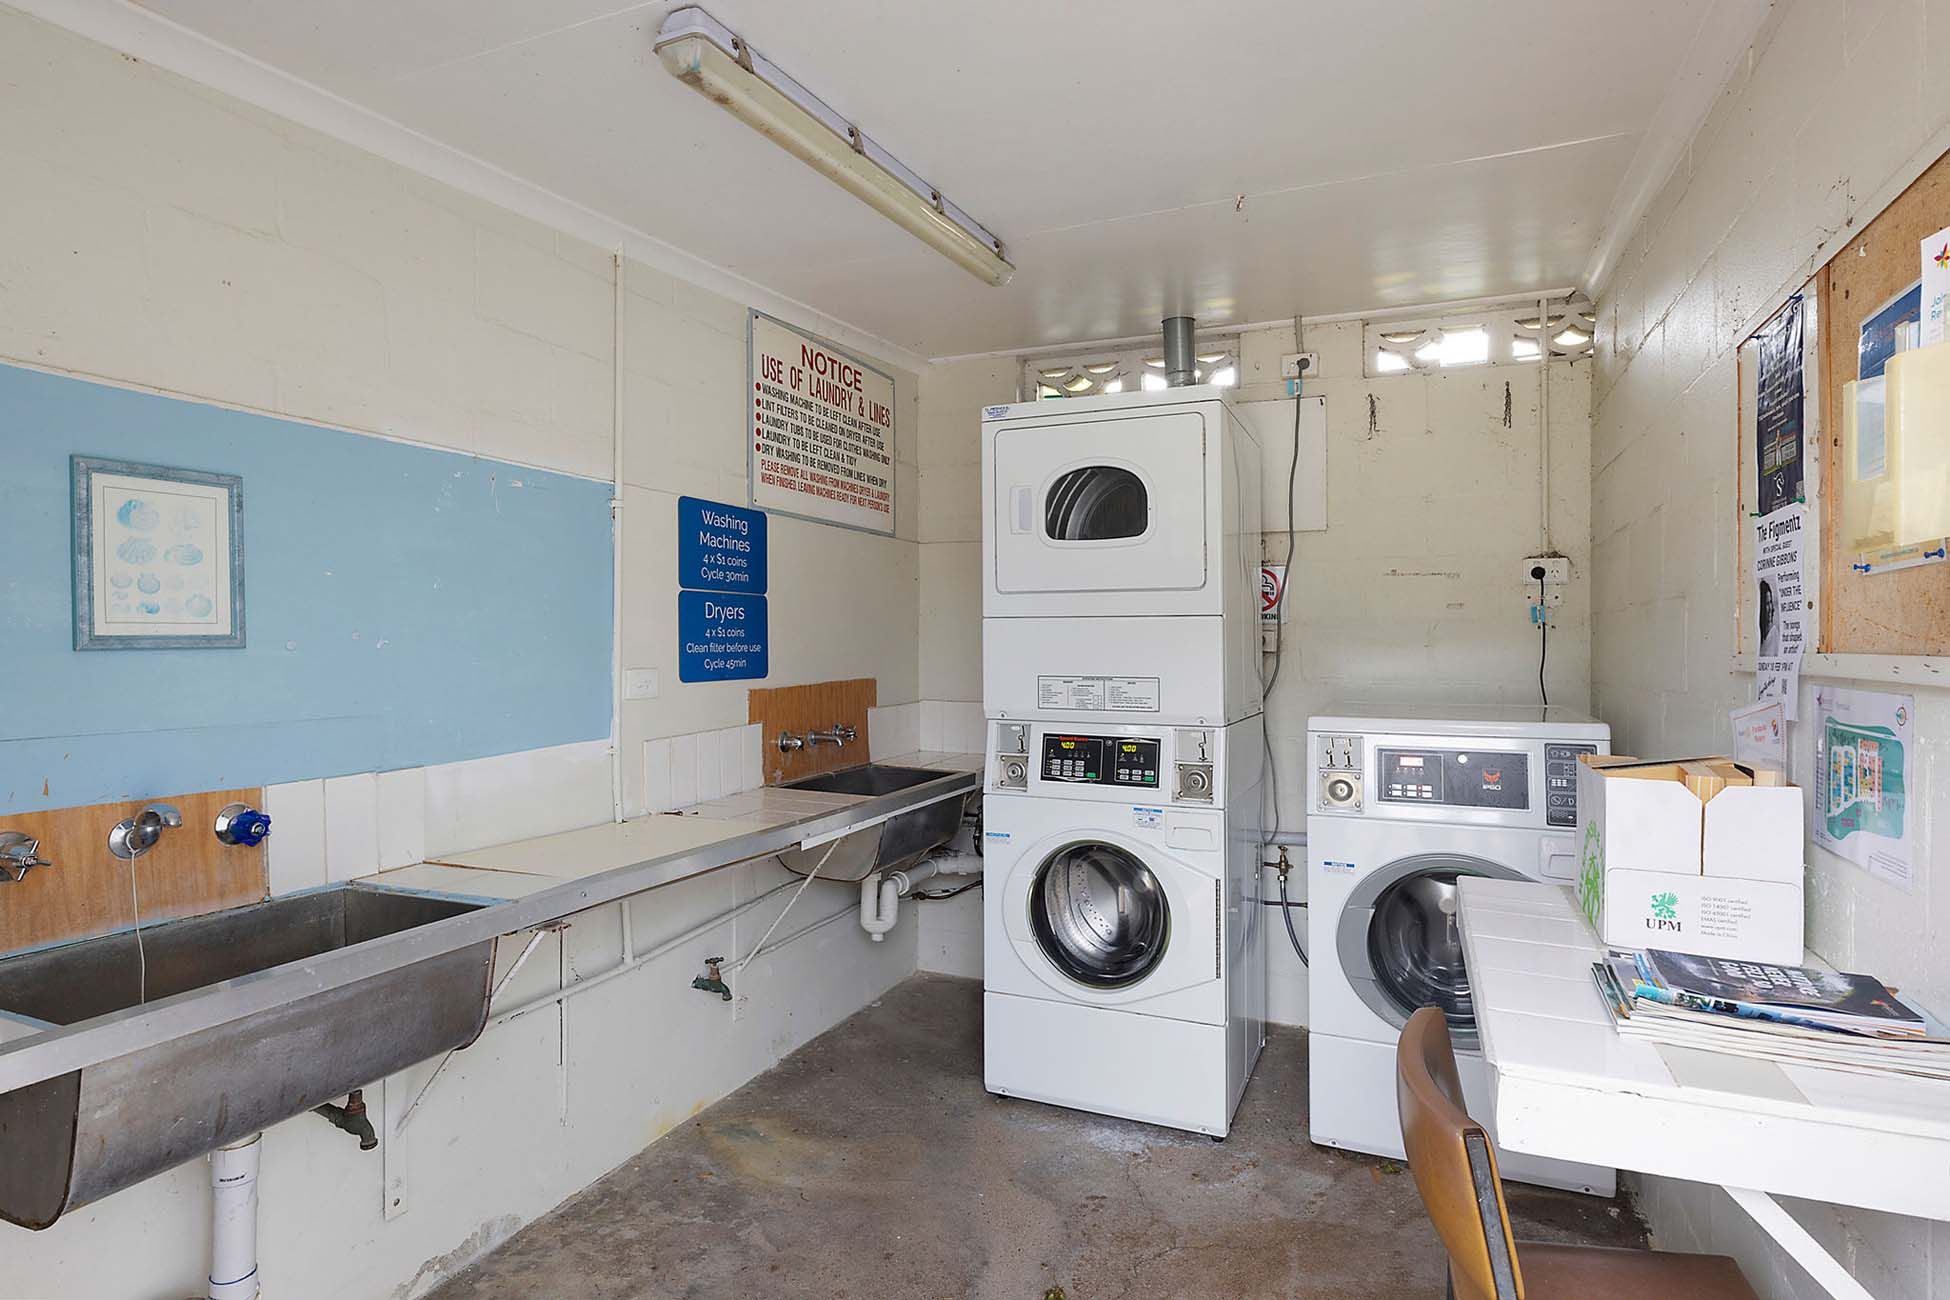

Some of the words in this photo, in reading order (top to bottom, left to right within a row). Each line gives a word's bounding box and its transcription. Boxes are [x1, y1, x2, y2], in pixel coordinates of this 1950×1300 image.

[801, 344, 863, 392] NOTICE
[761, 353, 784, 385] USE
[790, 366, 803, 391] OF
[809, 374, 853, 412] LAUNDRY
[858, 396, 865, 418] &
[869, 399, 890, 428] LINES
[762, 383, 788, 402] WASHING
[790, 393, 814, 412] MACHINE
[815, 403, 822, 415] TO
[823, 406, 829, 418] BE
[830, 409, 841, 422] LEFT
[842, 414, 857, 428] CLEAN
[858, 420, 871, 434] AFTER
[762, 398, 774, 413] LINT
[776, 403, 798, 421] FILTERS
[800, 411, 807, 424] TO
[808, 414, 815, 426] BE
[815, 417, 837, 434] CLEANED
[839, 425, 845, 437] ON
[846, 428, 861, 443] DRYER
[862, 434, 875, 448] AFTER
[762, 413, 789, 432] LAUNDRY
[790, 422, 804, 436] TUBS
[805, 427, 811, 439] TO
[812, 430, 819, 442] BE
[820, 432, 832, 446] USED
[832, 437, 842, 449] FOR
[843, 440, 861, 456] CLOTHES
[762, 428, 790, 446] LAUNDRY
[792, 437, 800, 449] TO
[801, 440, 808, 452] BE
[809, 443, 822, 456] LEFT
[823, 447, 840, 461] CLEAN
[841, 453, 845, 463] &
[846, 454, 857, 467] TIDY
[761, 458, 779, 473] PLEASE
[780, 463, 800, 478] REMOVE
[800, 468, 808, 481] ALL
[762, 442, 774, 456] DRY
[776, 446, 800, 463] WASHING
[802, 454, 808, 466] TO
[810, 457, 816, 468] BE
[817, 458, 839, 475] REMOVED
[840, 465, 853, 478] FROM
[854, 469, 865, 482] LINES
[866, 474, 878, 487] WHEN
[879, 477, 887, 489] DRY
[761, 471, 775, 485] WHEN
[701, 509, 748, 535] Washing
[1757, 524, 1767, 542] The
[1768, 514, 1801, 541] Figmentz
[699, 530, 751, 552] Machines
[703, 554, 708, 564] 4
[709, 555, 715, 563] x
[716, 552, 726, 565] $1
[726, 555, 748, 568] coins
[1757, 556, 1776, 571] CORINNE
[1776, 550, 1797, 567] GIBBONS
[701, 566, 724, 581] Cycle
[725, 571, 749, 583] 30min
[1777, 570, 1800, 583] Performing
[1792, 585, 1802, 595] THE
[705, 601, 745, 623] Dryers
[705, 629, 710, 638] 4
[711, 629, 716, 637] x
[717, 627, 725, 637] $1
[726, 628, 745, 637] coins
[686, 642, 708, 653] Clean
[709, 642, 725, 653] filter
[726, 642, 748, 653] before
[749, 644, 761, 652] use
[704, 658, 725, 671] Cycle
[725, 658, 747, 669] 45min
[1645, 918, 1682, 932] UPM
